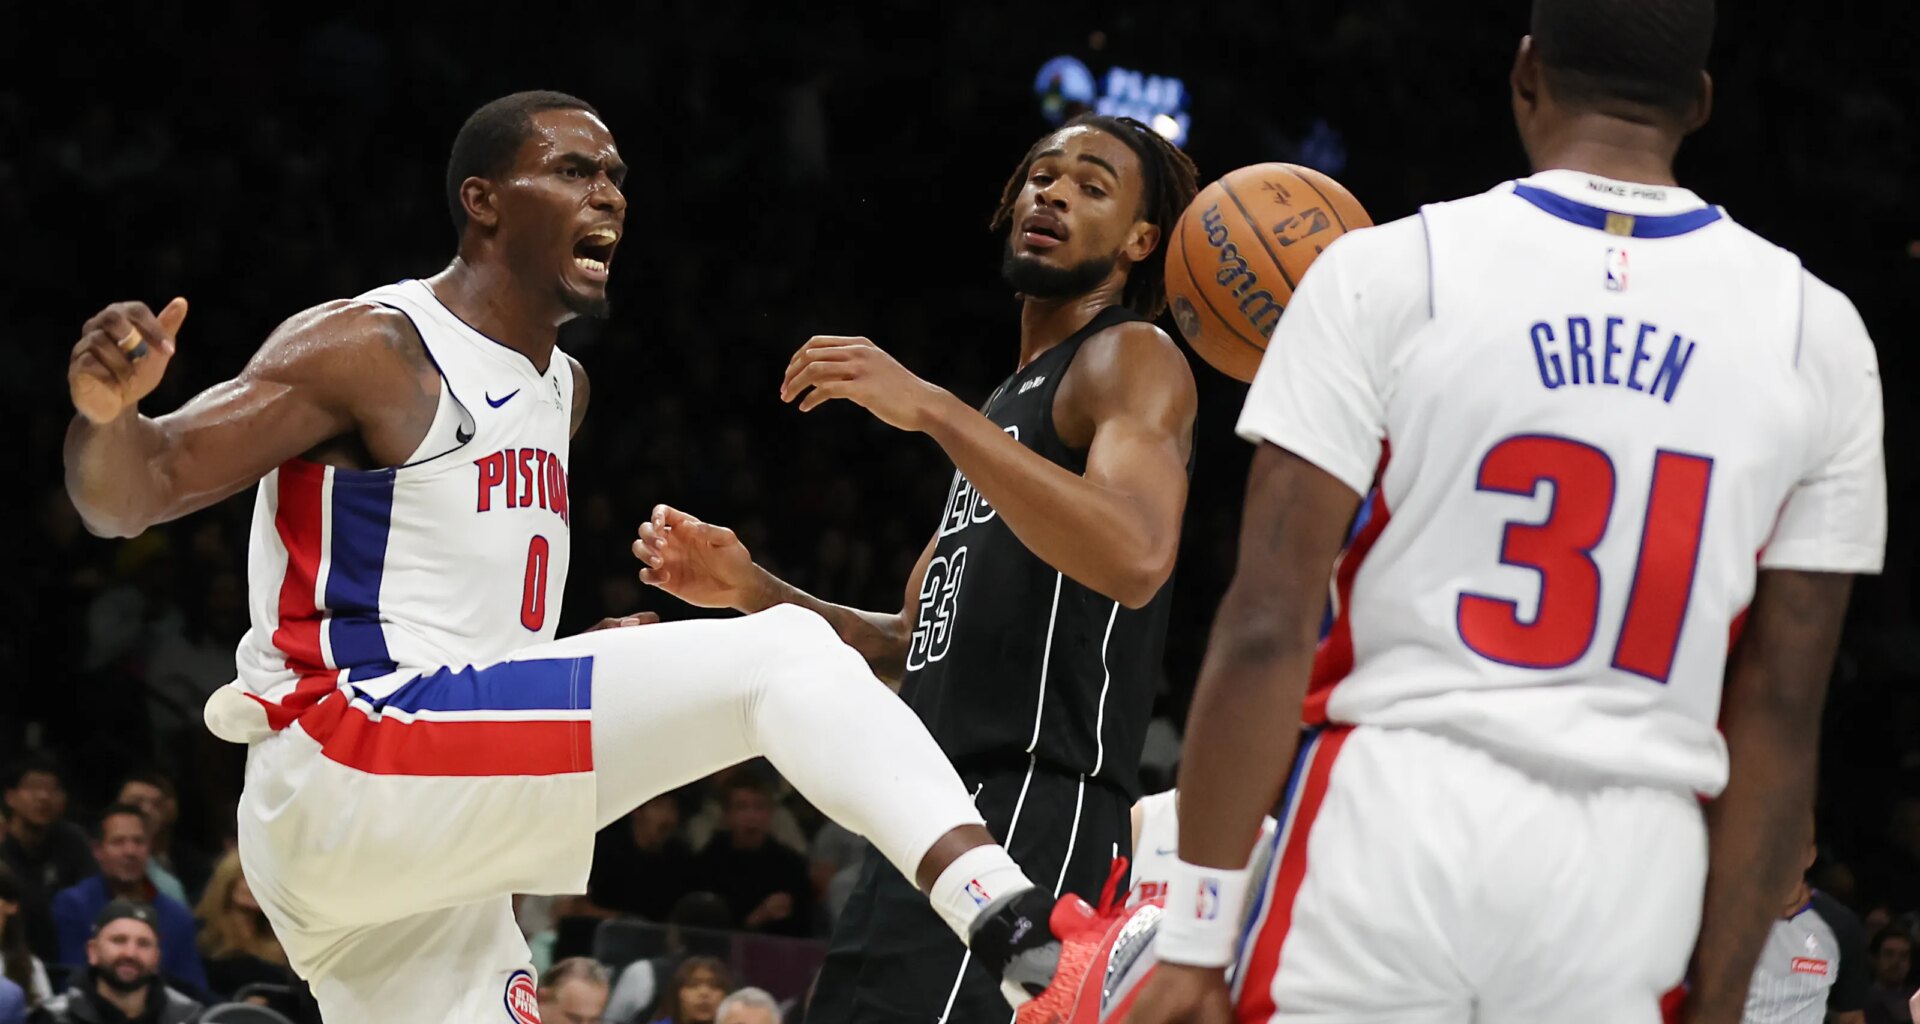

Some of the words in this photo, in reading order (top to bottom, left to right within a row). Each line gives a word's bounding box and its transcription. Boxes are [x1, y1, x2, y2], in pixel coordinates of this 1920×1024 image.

[1588, 181, 1626, 197] NIKE
[1530, 315, 1696, 403] GREEN
[473, 447, 570, 528] PISTON
[520, 534, 549, 632] 0
[1456, 432, 1714, 684] 31
[905, 545, 968, 672] 33
